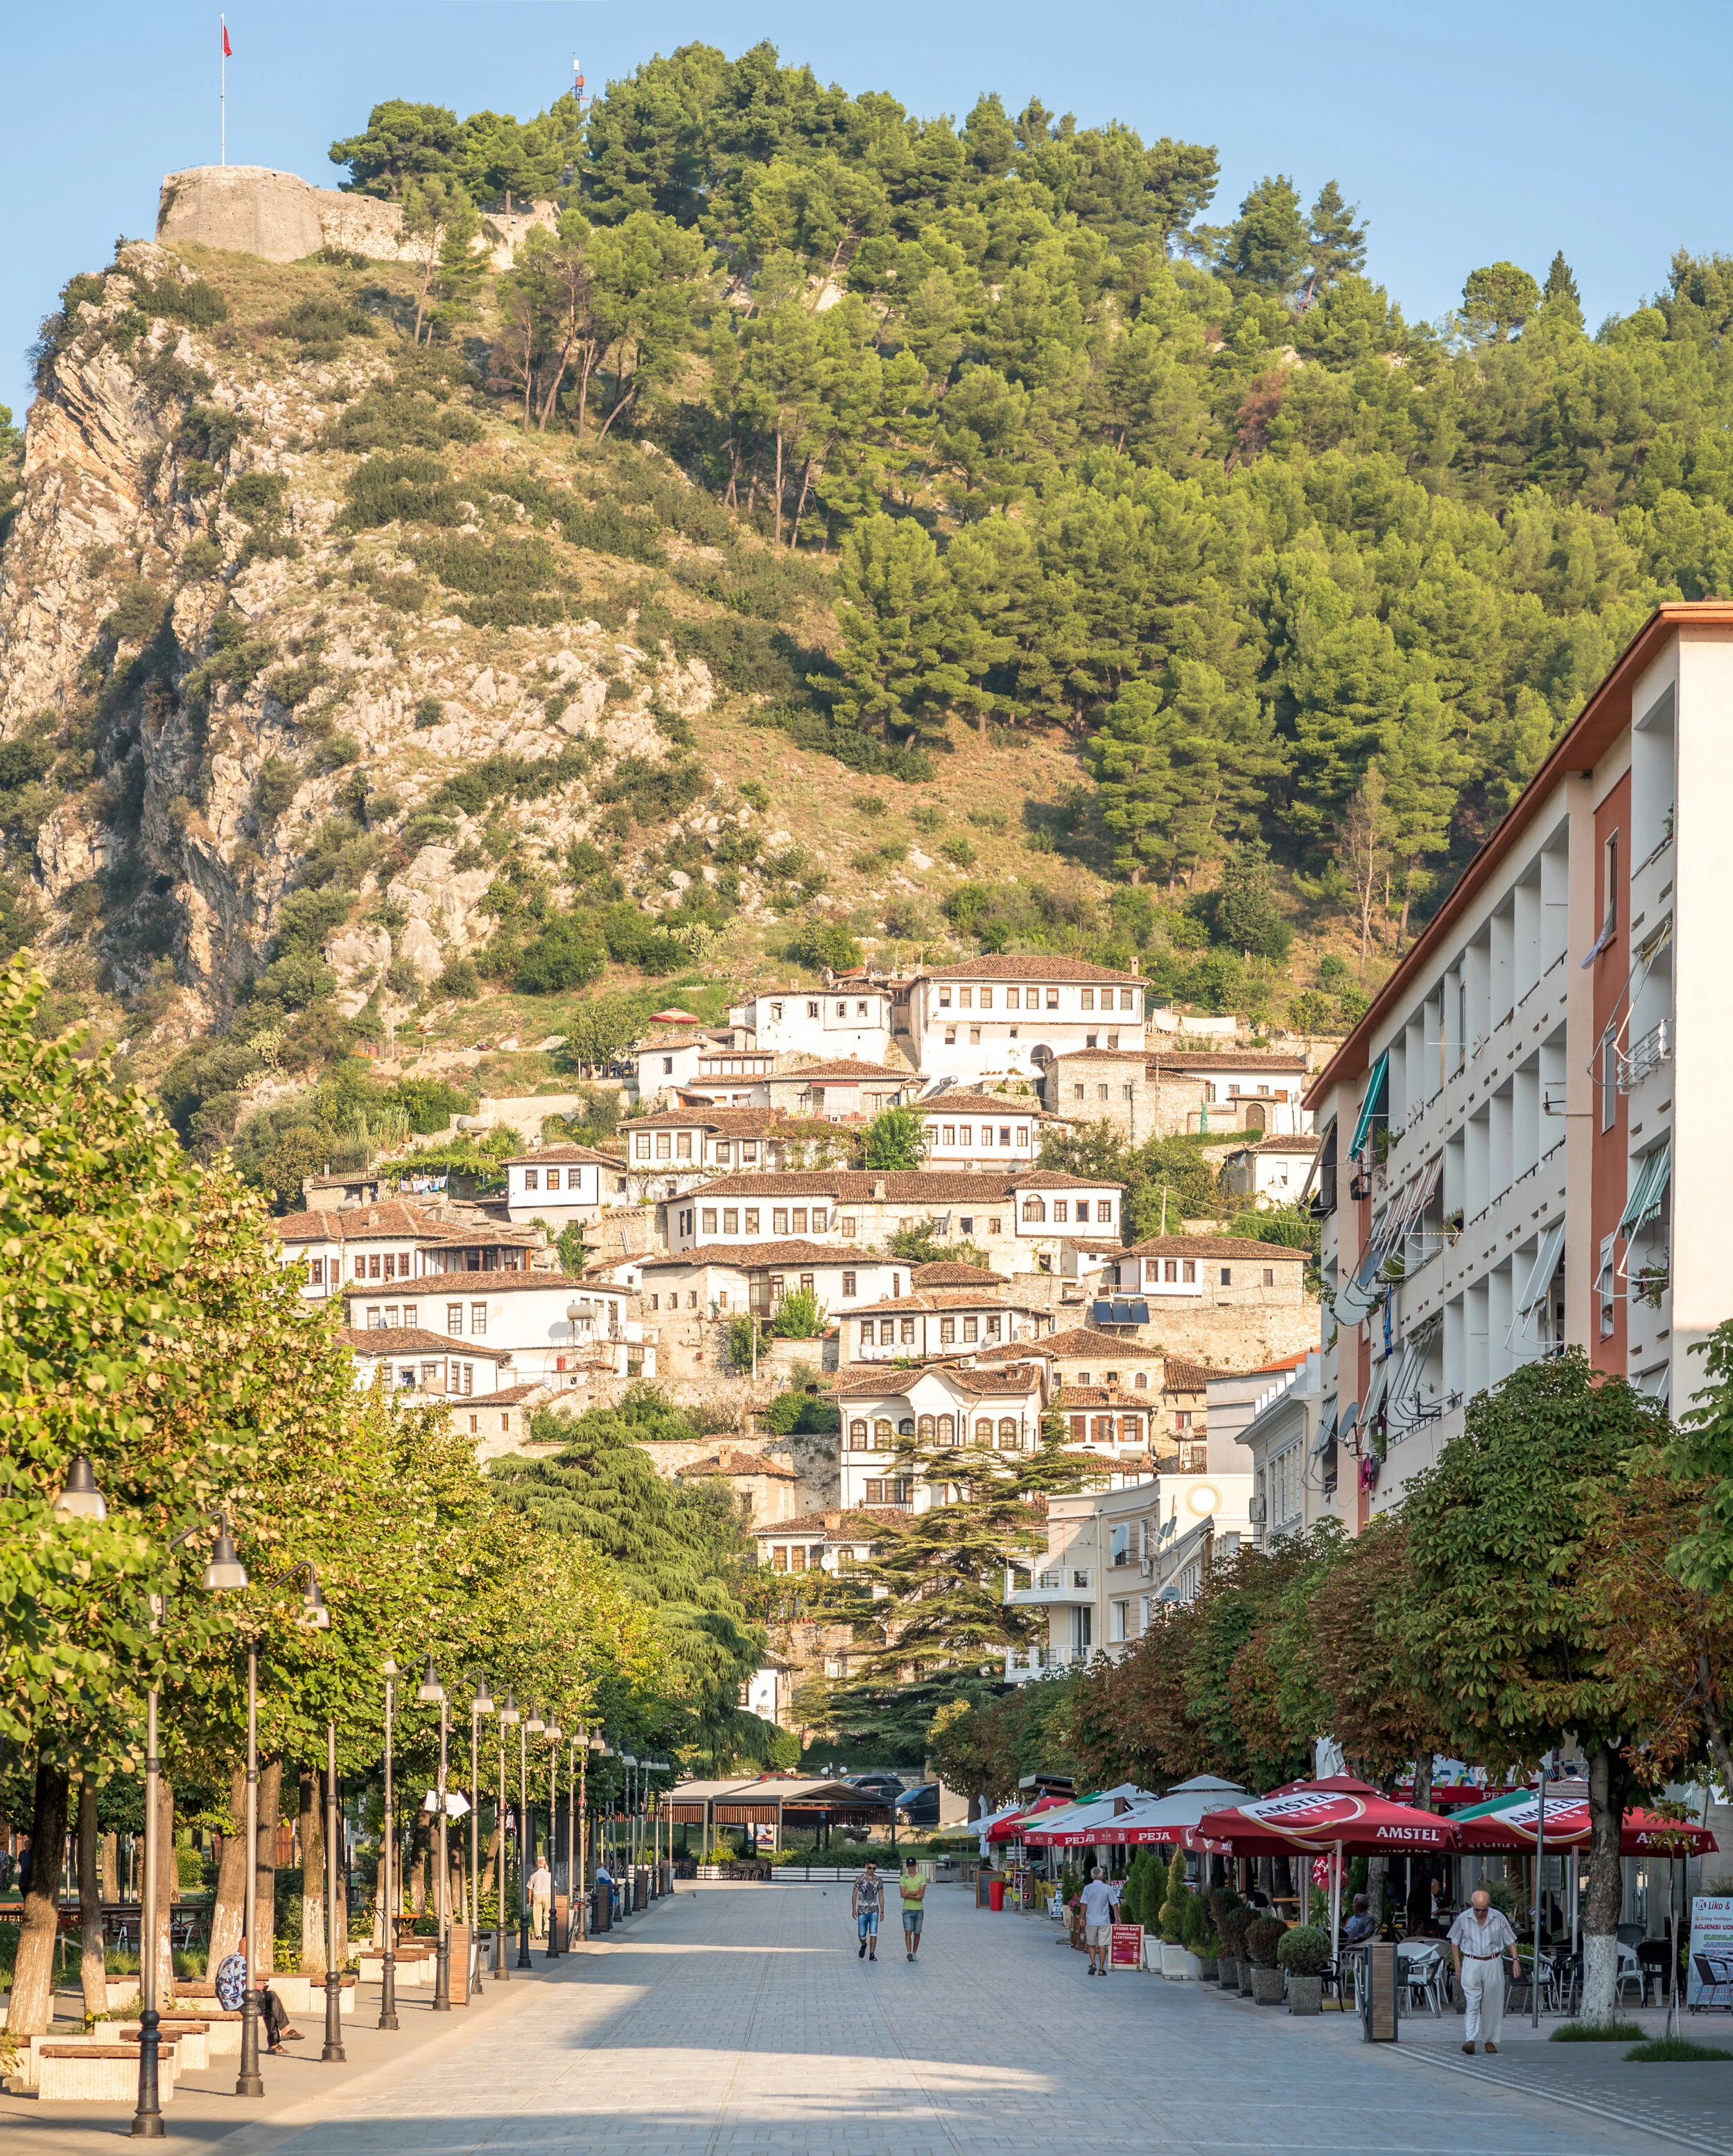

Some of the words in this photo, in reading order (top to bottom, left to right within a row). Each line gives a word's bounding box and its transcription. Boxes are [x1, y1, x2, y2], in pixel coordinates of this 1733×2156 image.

[1254, 1793, 1336, 1816] AMSTEL
[1287, 1805, 1336, 1818] BEER
[1508, 1799, 1580, 1823] AMSTEL
[1544, 1809, 1585, 1824] BEER
[1138, 1832, 1171, 1841] PEJA
[1376, 1826, 1440, 1841] AMSTEL
[1065, 1837, 1085, 1845] PEJ
[1708, 1901, 1723, 1910] Liko
[1725, 1901, 1730, 1910] &
